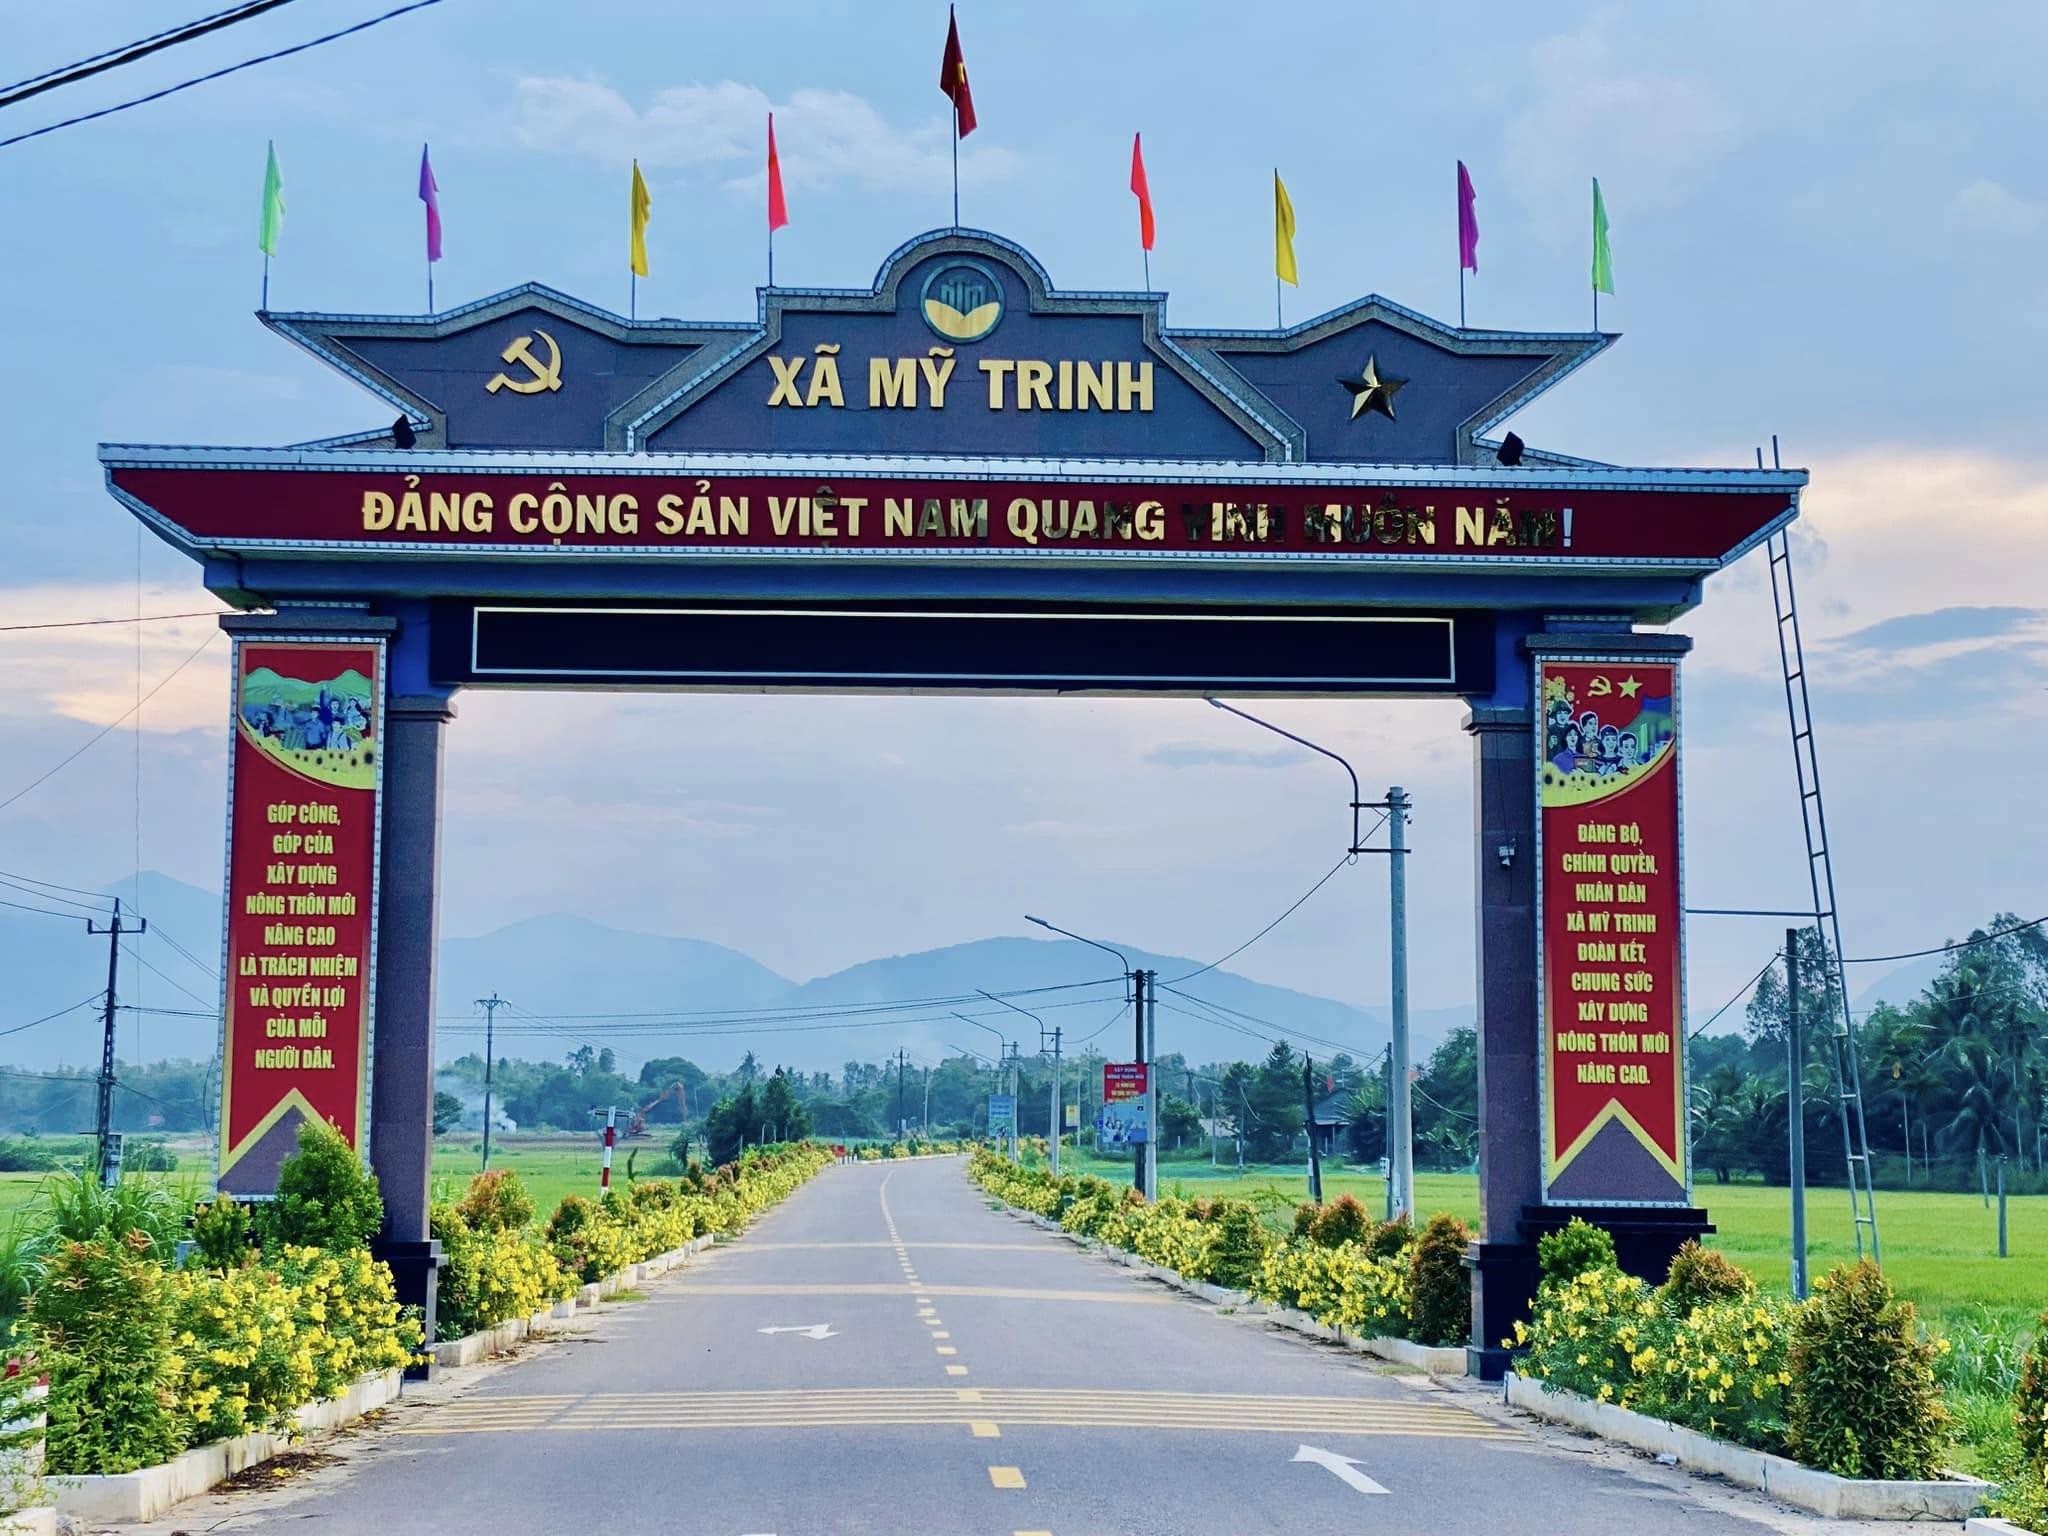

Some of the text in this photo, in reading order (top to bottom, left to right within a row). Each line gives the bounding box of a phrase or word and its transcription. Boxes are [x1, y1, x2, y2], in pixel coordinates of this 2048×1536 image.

[767, 344, 1154, 411] XÃ MỸ TRINH
[362, 475, 1574, 548] ĐẢNG CỘNG SẢN VIỆT NAM QUANG VINH MUÔN NĂM!
[267, 800, 341, 826] GÓP CÔNG,
[272, 830, 334, 854] GÓP CỦA
[1578, 820, 1643, 847] ĐẢNG BỘ,
[266, 861, 337, 888] XÂY DỰNG
[1562, 848, 1659, 875] CHÍNH QUYỀN,
[246, 891, 356, 916] NÔNG THÔN MỚI
[1576, 880, 1646, 903] NHÂN DÂN
[264, 922, 336, 946] NÂNG CAO
[1567, 910, 1657, 933] XÃ MỸ TRINH
[1577, 937, 1647, 964] ĐOÀN KẾT,
[240, 952, 358, 980] LÀ TRÁCH NHIỆM
[1571, 970, 1653, 992] CHUNG SỨC
[250, 983, 270, 1007] VÀ
[323, 985, 346, 1012] LỢI
[266, 1011, 327, 1038] CỦA MỖI
[1578, 999, 1648, 1025] XÂY DỰNG
[1557, 1030, 1670, 1053] NÔNG THÔN MỚI
[255, 1045, 335, 1069] NGƯỜI DÂN.
[1577, 1061, 1651, 1085] NÂNG CAO.
